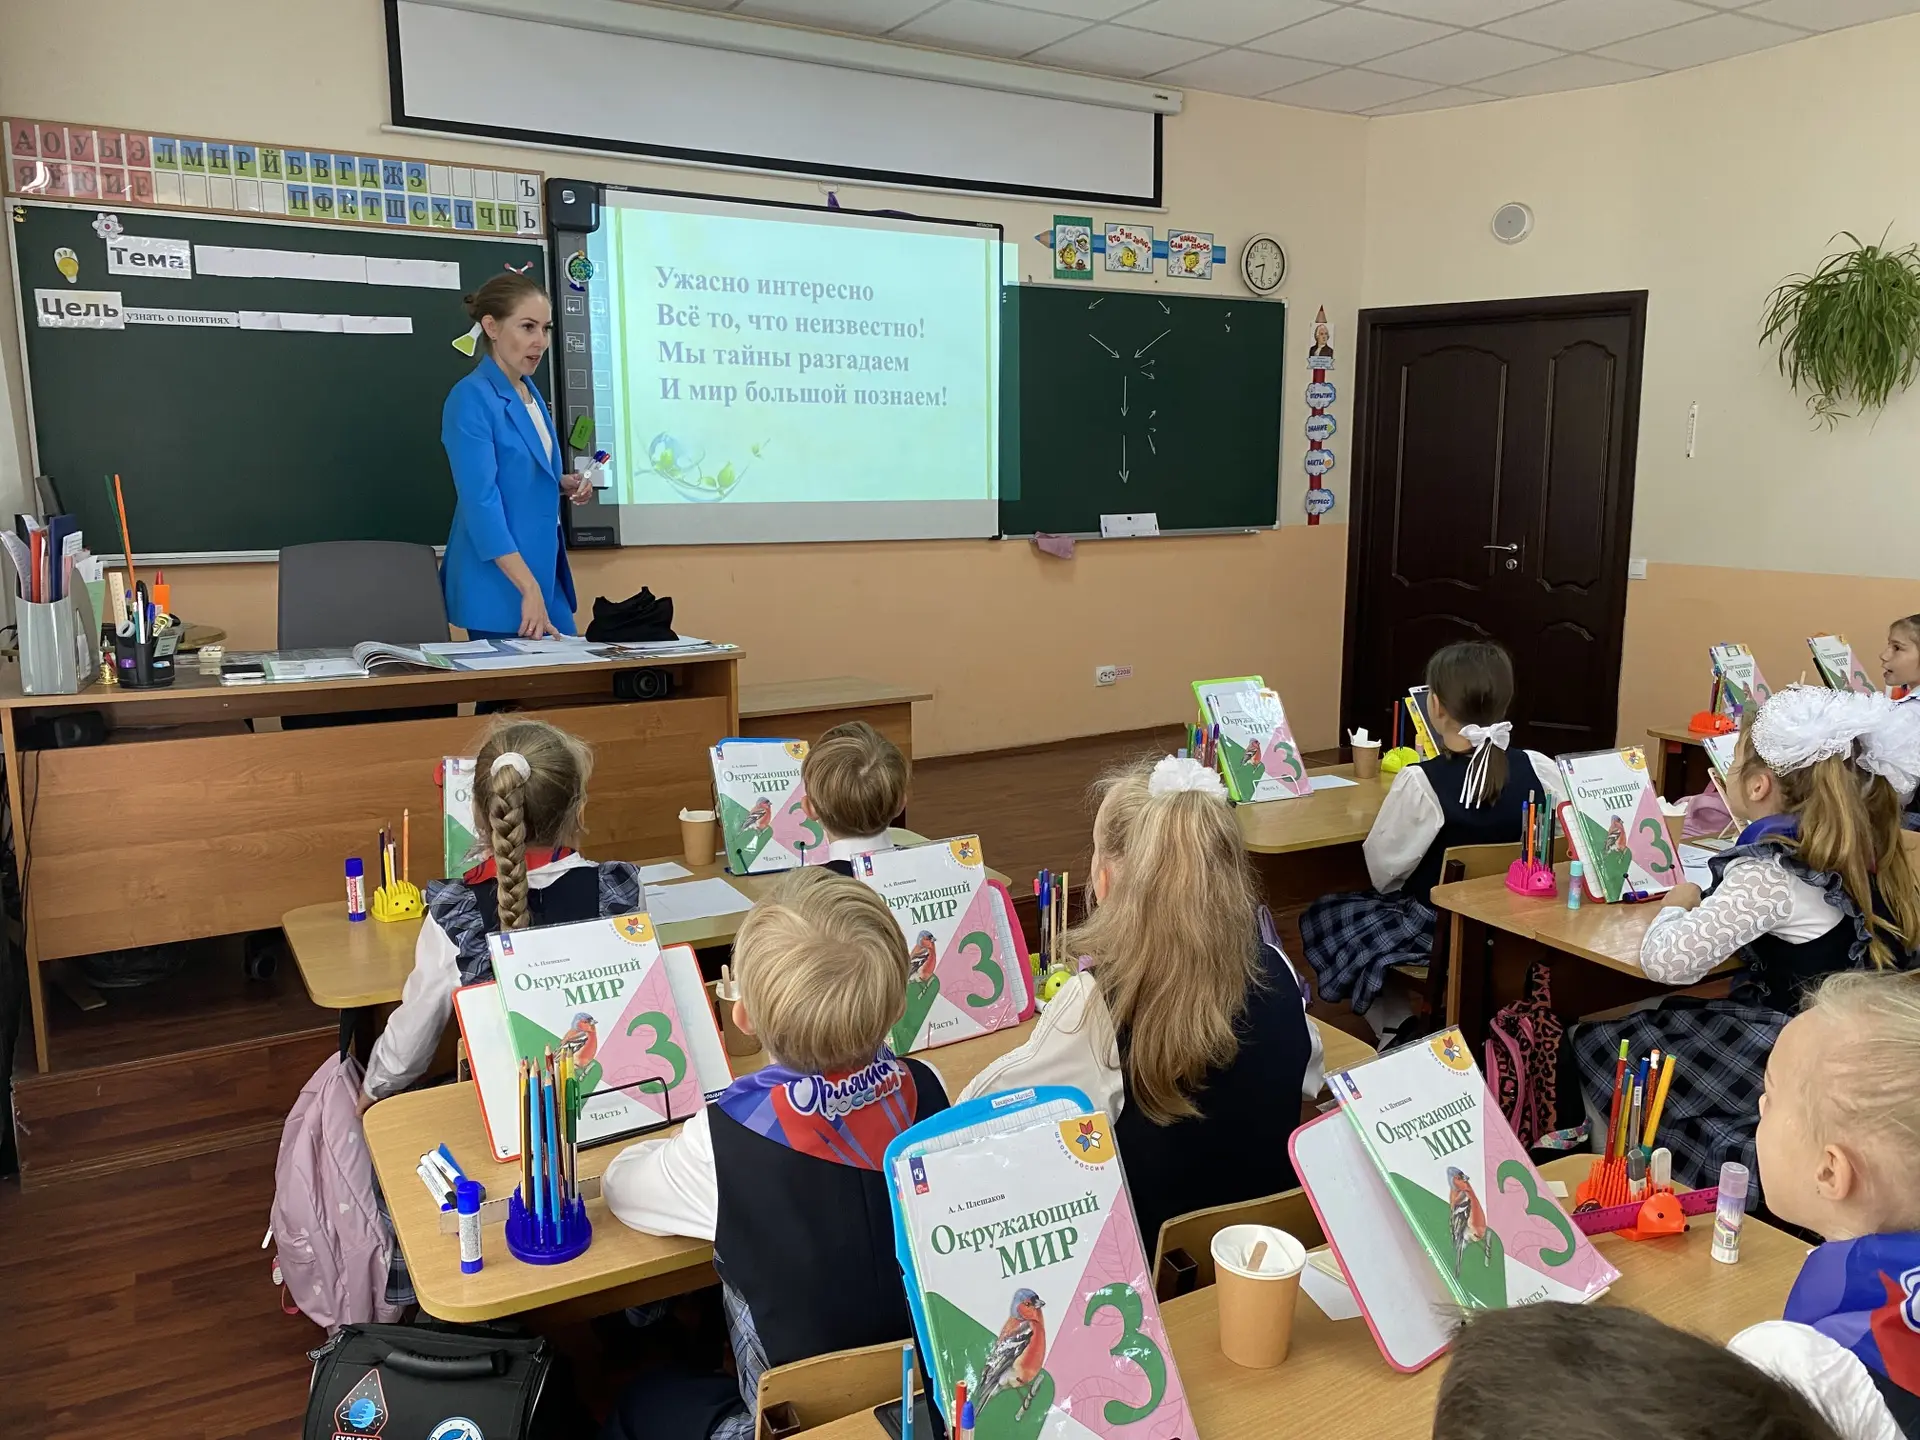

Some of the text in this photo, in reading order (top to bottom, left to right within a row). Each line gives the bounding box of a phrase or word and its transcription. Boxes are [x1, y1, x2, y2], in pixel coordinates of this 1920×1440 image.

[16, 130, 535, 197] А О У Ы Э Л М Н Р Й Б В Г Д Ж З Ъ
[105, 173, 123, 193] И
[136, 177, 149, 195] Е
[291, 190, 308, 209] П
[315, 193, 333, 211] Ф
[366, 197, 378, 215] Т
[386, 199, 405, 218] Ш
[413, 202, 425, 220] С
[433, 204, 450, 221] Х
[457, 205, 472, 228] Ц
[479, 208, 495, 225] Ч
[499, 209, 518, 230] Щ
[525, 211, 535, 228] Ь
[110, 247, 184, 269] Тема
[656, 266, 874, 303] Ужасно интересно
[41, 298, 119, 319] Цель
[126, 312, 164, 324] узнать
[177, 315, 230, 325] понятиях
[656, 304, 925, 338] Всё то, что неизвестно!
[658, 341, 909, 373] Мы тайны разгадаем
[660, 377, 947, 407] И мир большой познаем!
[724, 768, 800, 783] Окружающий
[1274, 741, 1302, 782] 3
[752, 779, 790, 793] МИР
[1577, 781, 1640, 799] Окружающий
[1602, 794, 1633, 811] МИР
[1639, 818, 1673, 873] 3
[911, 899, 958, 926] МИР
[514, 958, 642, 993] Окружающий
[958, 931, 1004, 1008] 3
[562, 978, 625, 1008] МИР
[929, 1018, 953, 1031] Часть
[626, 1011, 687, 1095] 3
[789, 1062, 894, 1113] Орлята
[590, 1106, 629, 1123] Часть 1
[1375, 1091, 1476, 1145] Окружающий
[1055, 1131, 1105, 1171] ШКОЛА РОССИИ
[1421, 1119, 1475, 1161] МИР
[948, 1193, 1006, 1214] А. А. Плешаков
[1496, 1159, 1575, 1267] 3
[930, 1191, 1101, 1256] Окружающий
[995, 1226, 1079, 1279] МИР
[1084, 1282, 1167, 1426] 3
